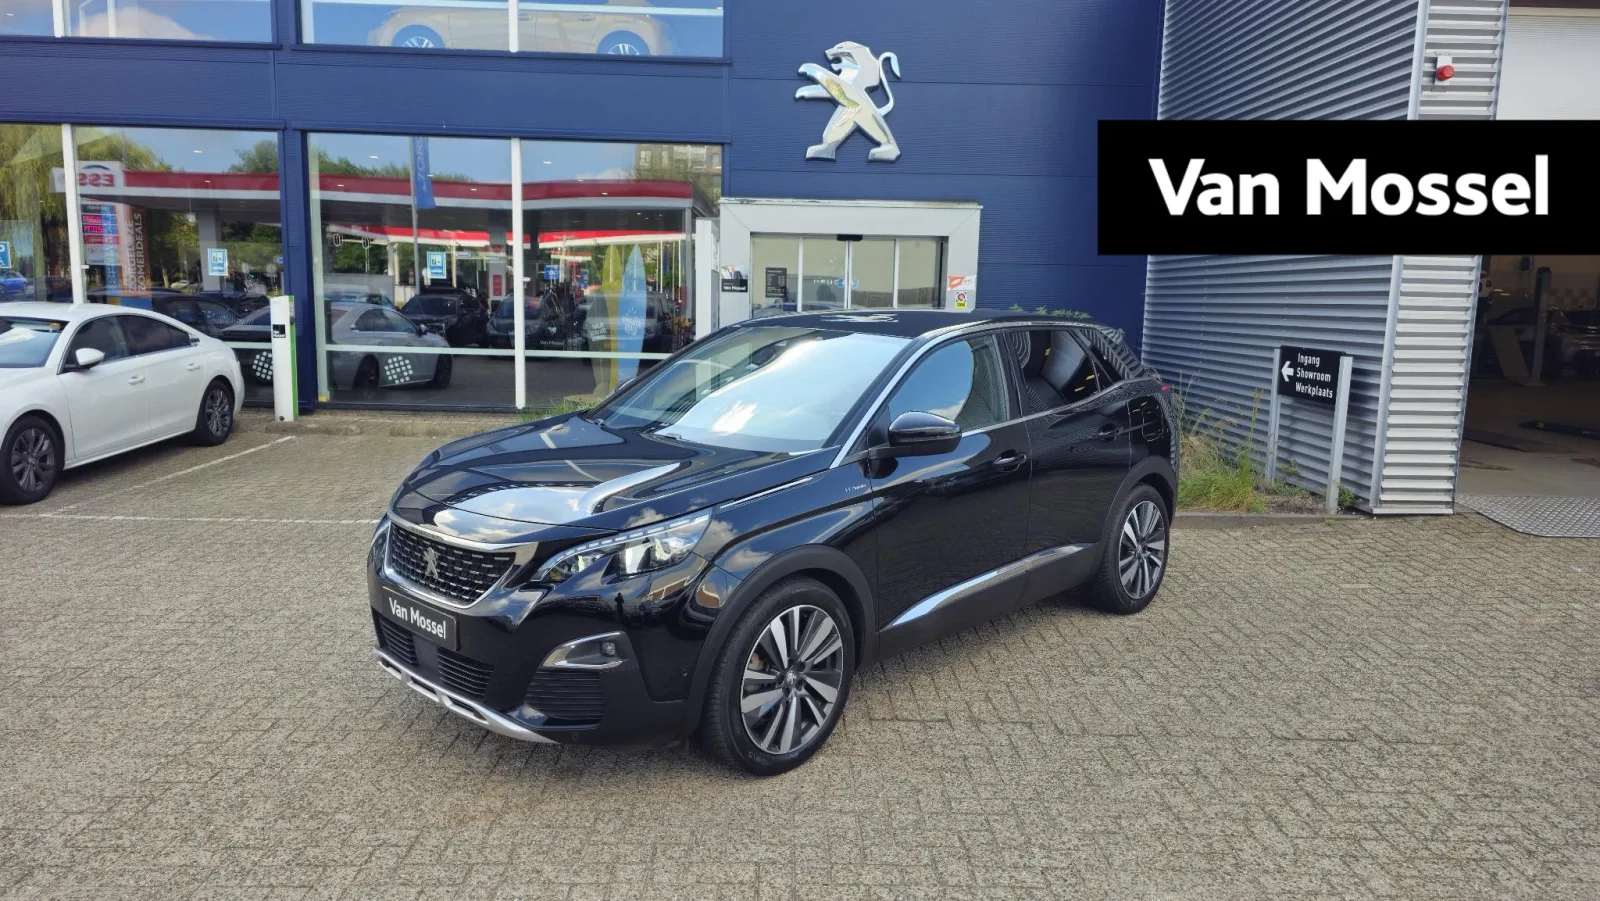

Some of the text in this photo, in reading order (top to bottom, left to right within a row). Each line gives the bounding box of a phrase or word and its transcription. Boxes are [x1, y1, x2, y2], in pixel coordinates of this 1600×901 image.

[134, 212, 146, 292] ZOMERDEALS
[1297, 352, 1320, 367] Ingang
[1296, 367, 1331, 382] Showroom
[1295, 381, 1333, 398] Werkplaats
[388, 597, 446, 640] Van Mossel
